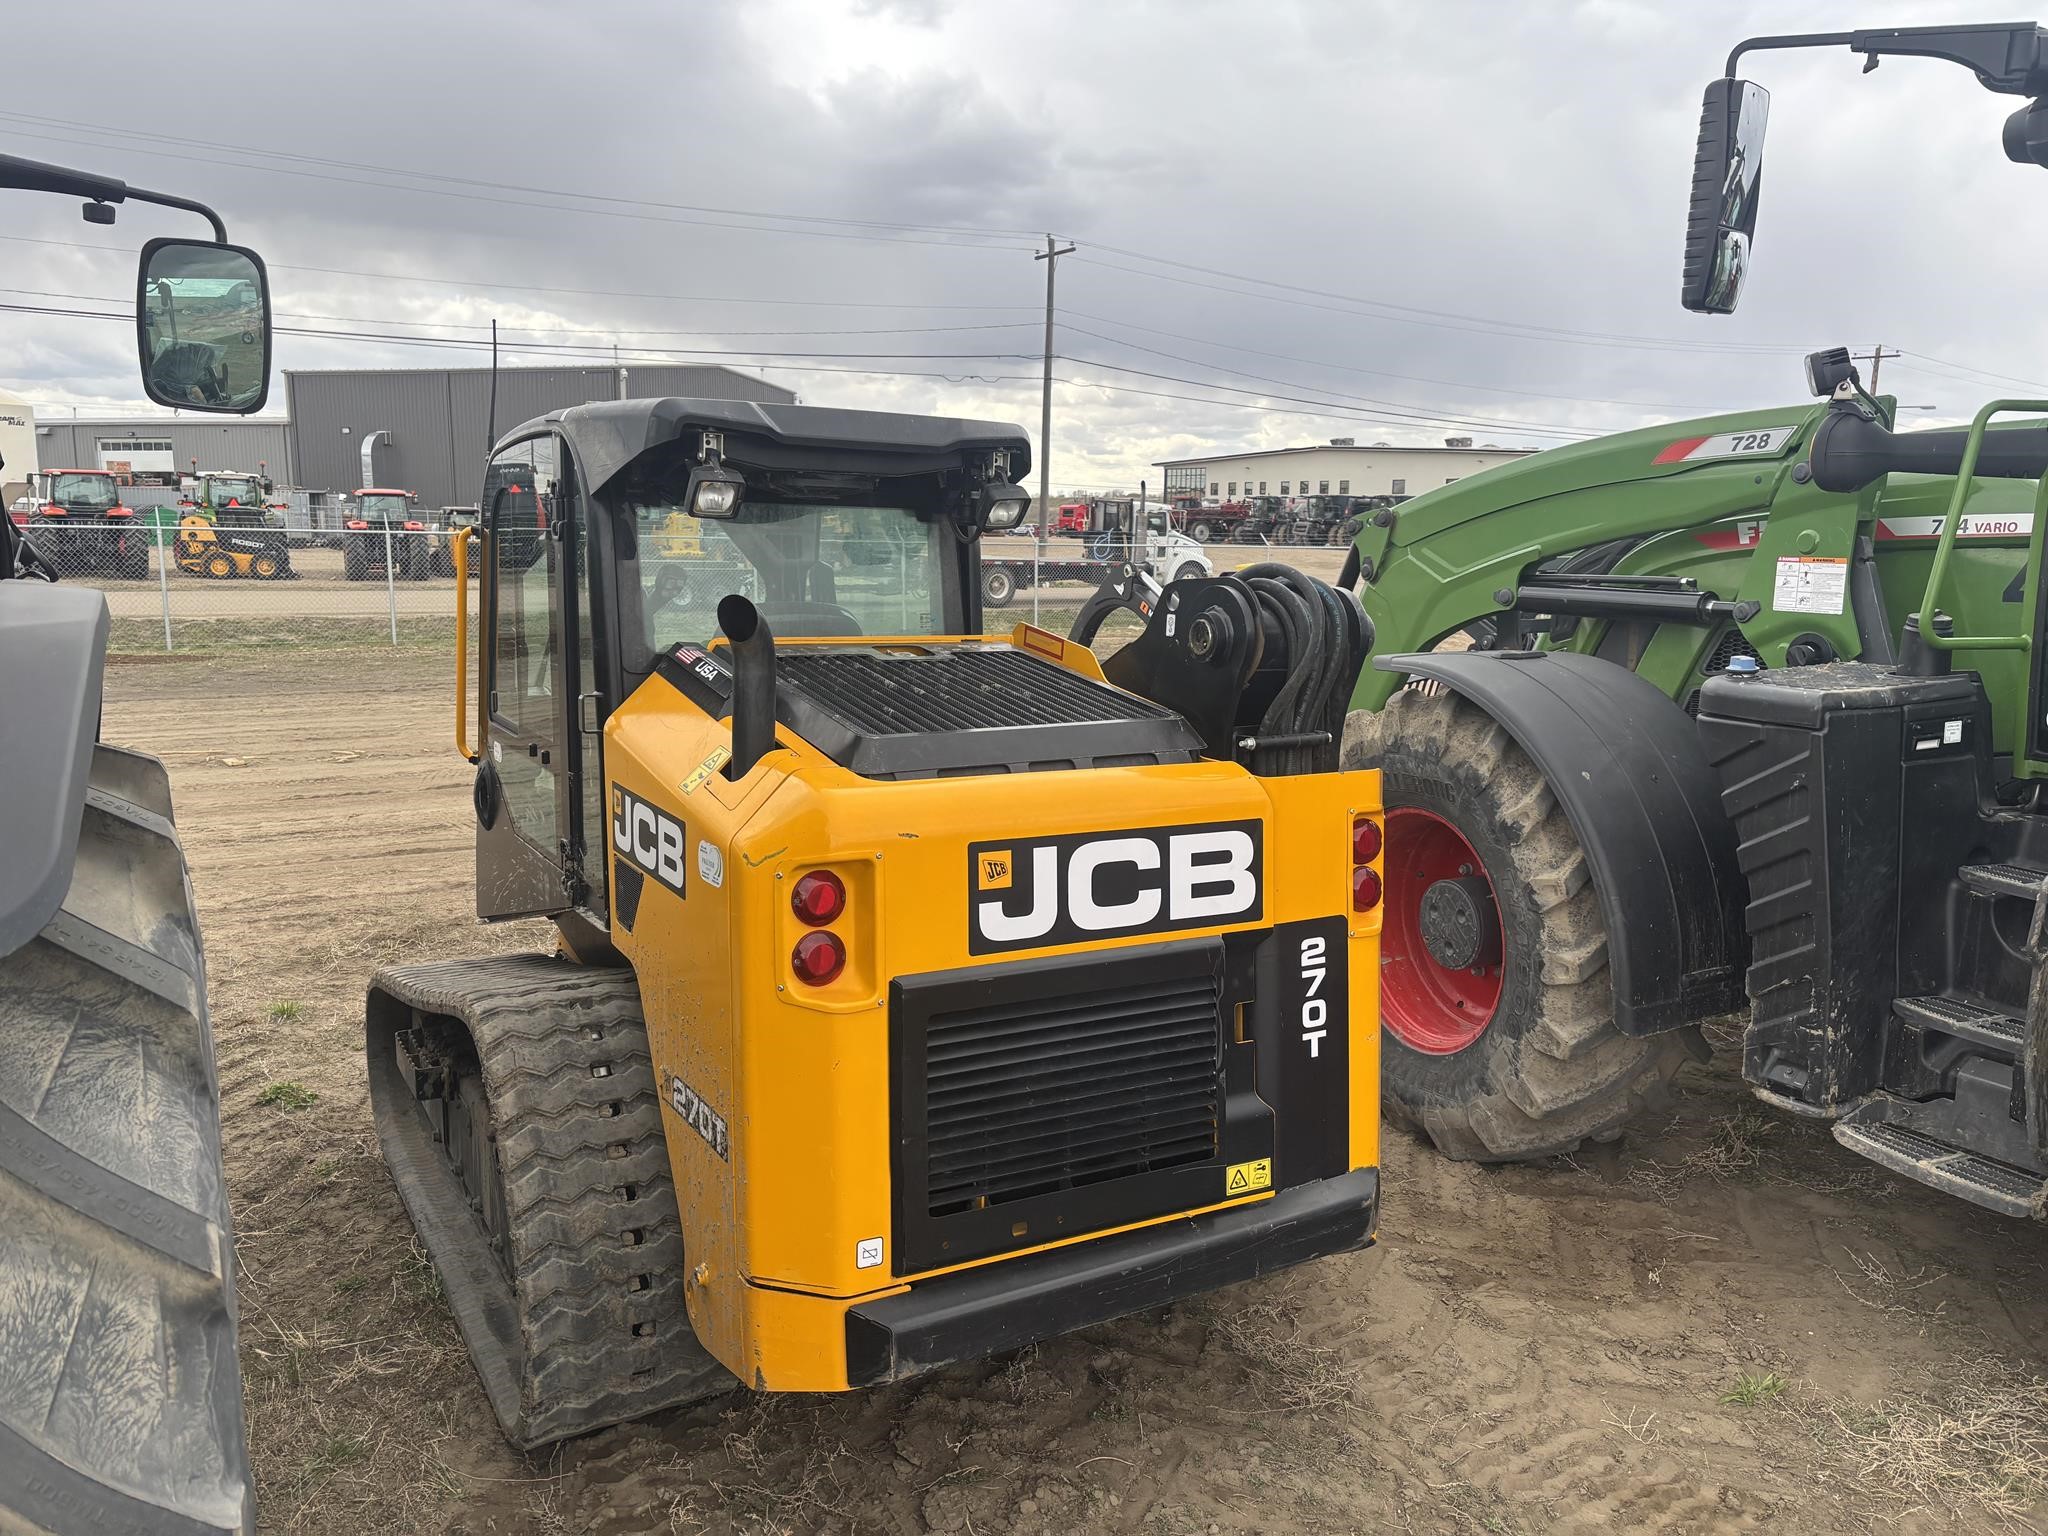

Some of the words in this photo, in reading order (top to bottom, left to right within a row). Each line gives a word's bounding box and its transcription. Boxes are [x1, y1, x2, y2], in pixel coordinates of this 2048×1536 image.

[1731, 433, 1771, 452] 728
[1931, 519, 1969, 534] 74
[1974, 521, 2018, 533] VARIO
[231, 538, 265, 549] ROBOT
[695, 661, 718, 681] USA
[613, 794, 685, 889] JCB
[987, 861, 1007, 879] JCB
[978, 830, 1257, 942] JCB
[1301, 936, 1327, 1058] 270T
[673, 1077, 727, 1155] 270T
